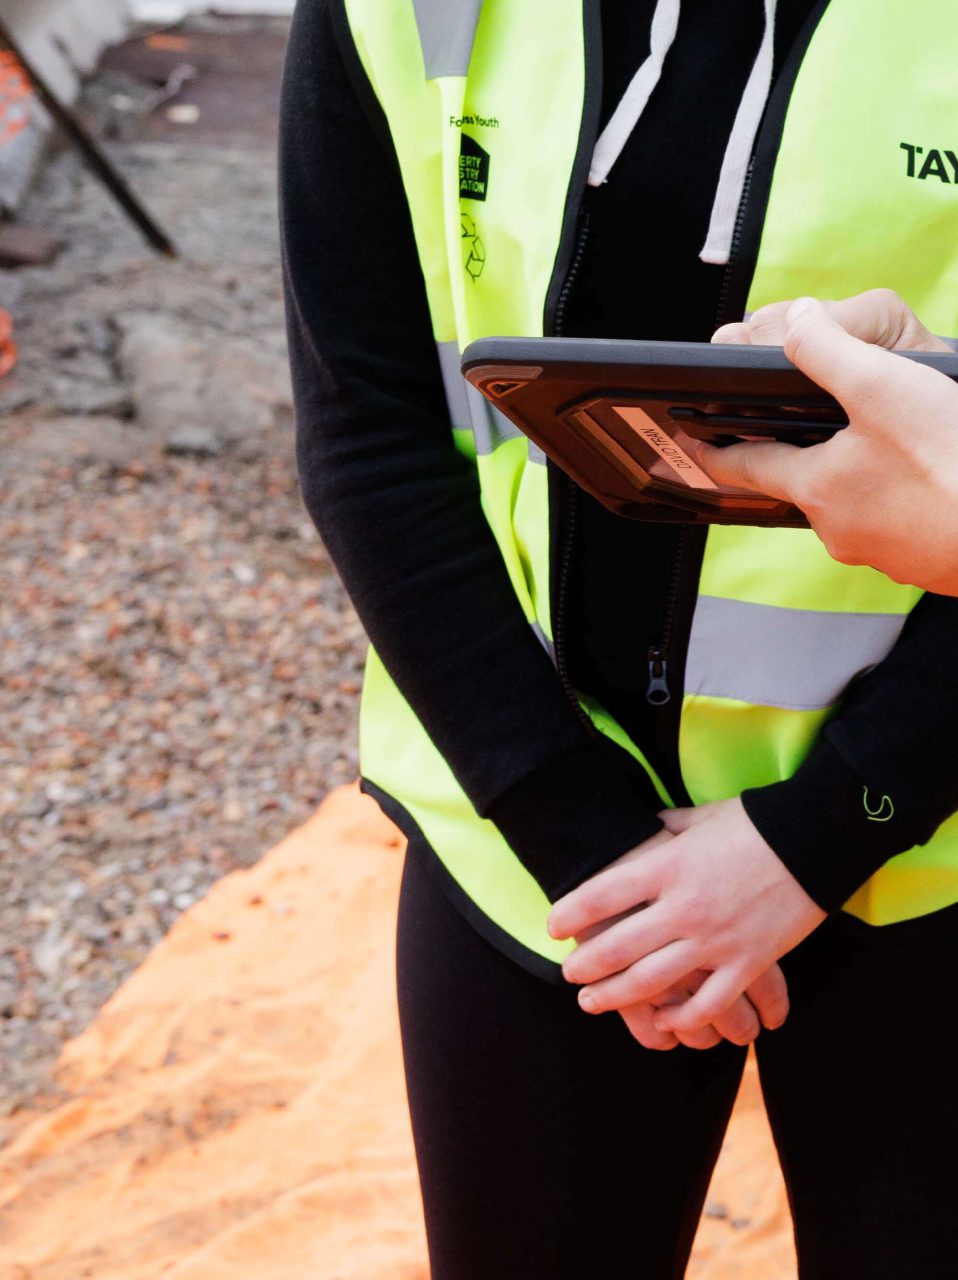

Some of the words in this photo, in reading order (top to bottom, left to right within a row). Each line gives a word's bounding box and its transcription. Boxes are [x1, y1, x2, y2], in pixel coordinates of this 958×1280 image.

[474, 114, 500, 128] Youth
[459, 155, 482, 169] ERTY
[459, 167, 480, 181] STRY
[460, 179, 485, 194] ATION
[640, 428, 671, 447] TRAN
[660, 447, 692, 469] DAVID
